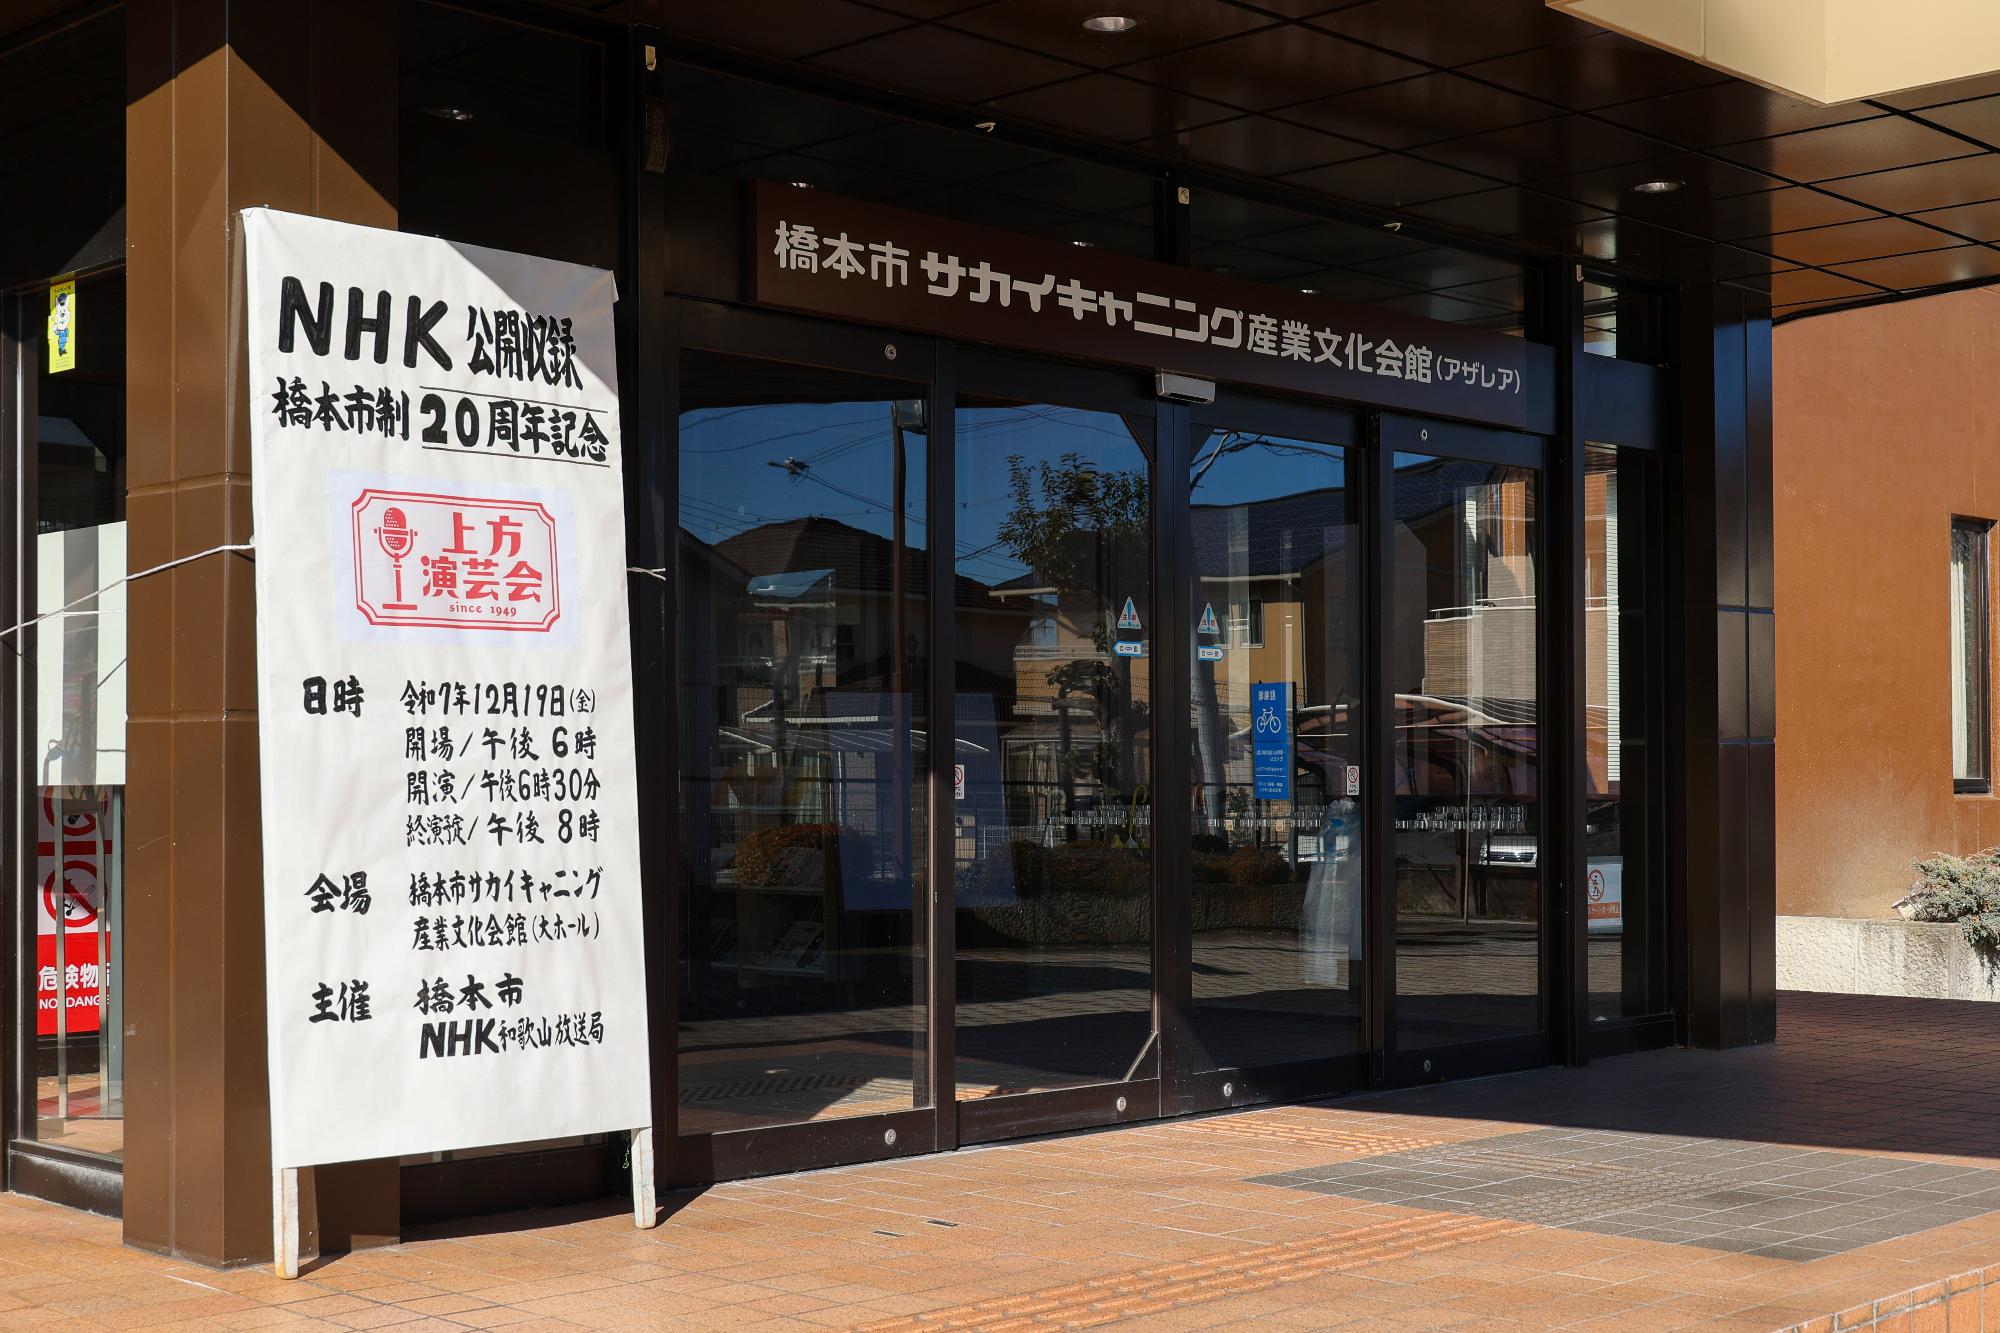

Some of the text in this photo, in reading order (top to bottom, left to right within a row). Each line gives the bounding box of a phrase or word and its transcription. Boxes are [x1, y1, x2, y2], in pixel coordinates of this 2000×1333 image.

[441, 511, 524, 558] 上方
[420, 555, 544, 603] 演芸会
[449, 601, 518, 617] since 1949
[303, 675, 366, 718] 日時
[303, 866, 604, 915] 会場 橋本市サカイキャニング
[412, 912, 600, 951] 産業文化会館(大ホール)
[308, 972, 524, 1024] 主催 橋本市
